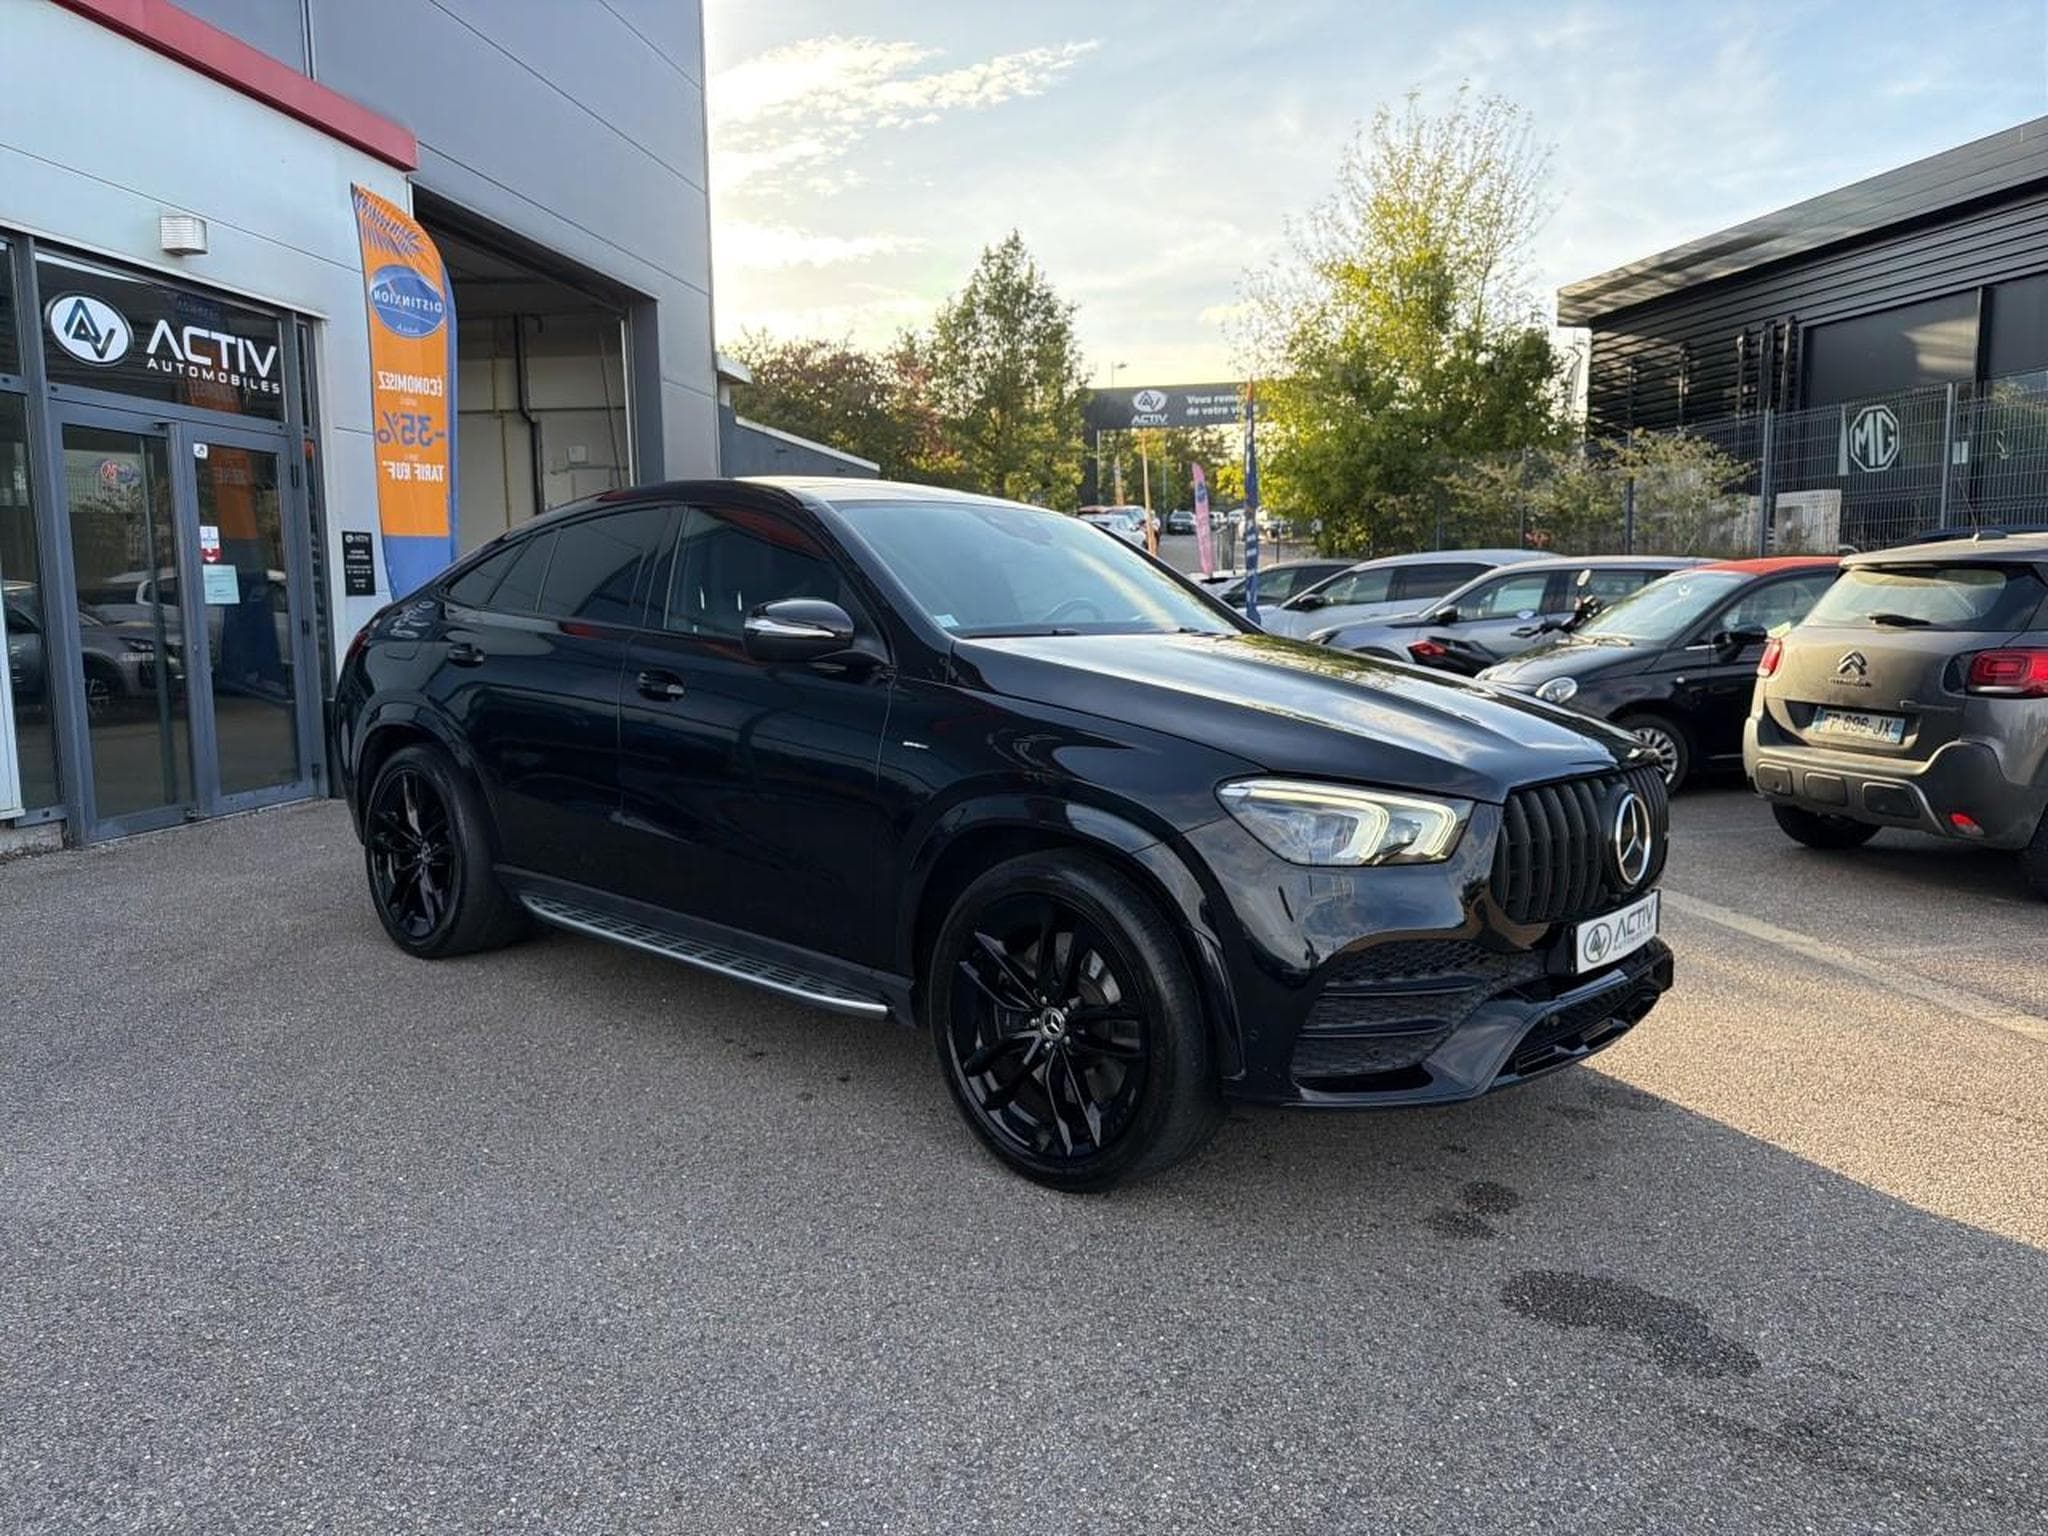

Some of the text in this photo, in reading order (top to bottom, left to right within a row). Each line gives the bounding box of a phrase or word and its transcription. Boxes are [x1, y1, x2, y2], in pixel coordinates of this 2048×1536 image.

[146, 319, 277, 378] ACTIV
[147, 358, 281, 394] AUTOMOBILES
[1131, 414, 1169, 425] ACTIV
[1855, 411, 1895, 466] MG
[1614, 899, 1656, 943] ACTIV
